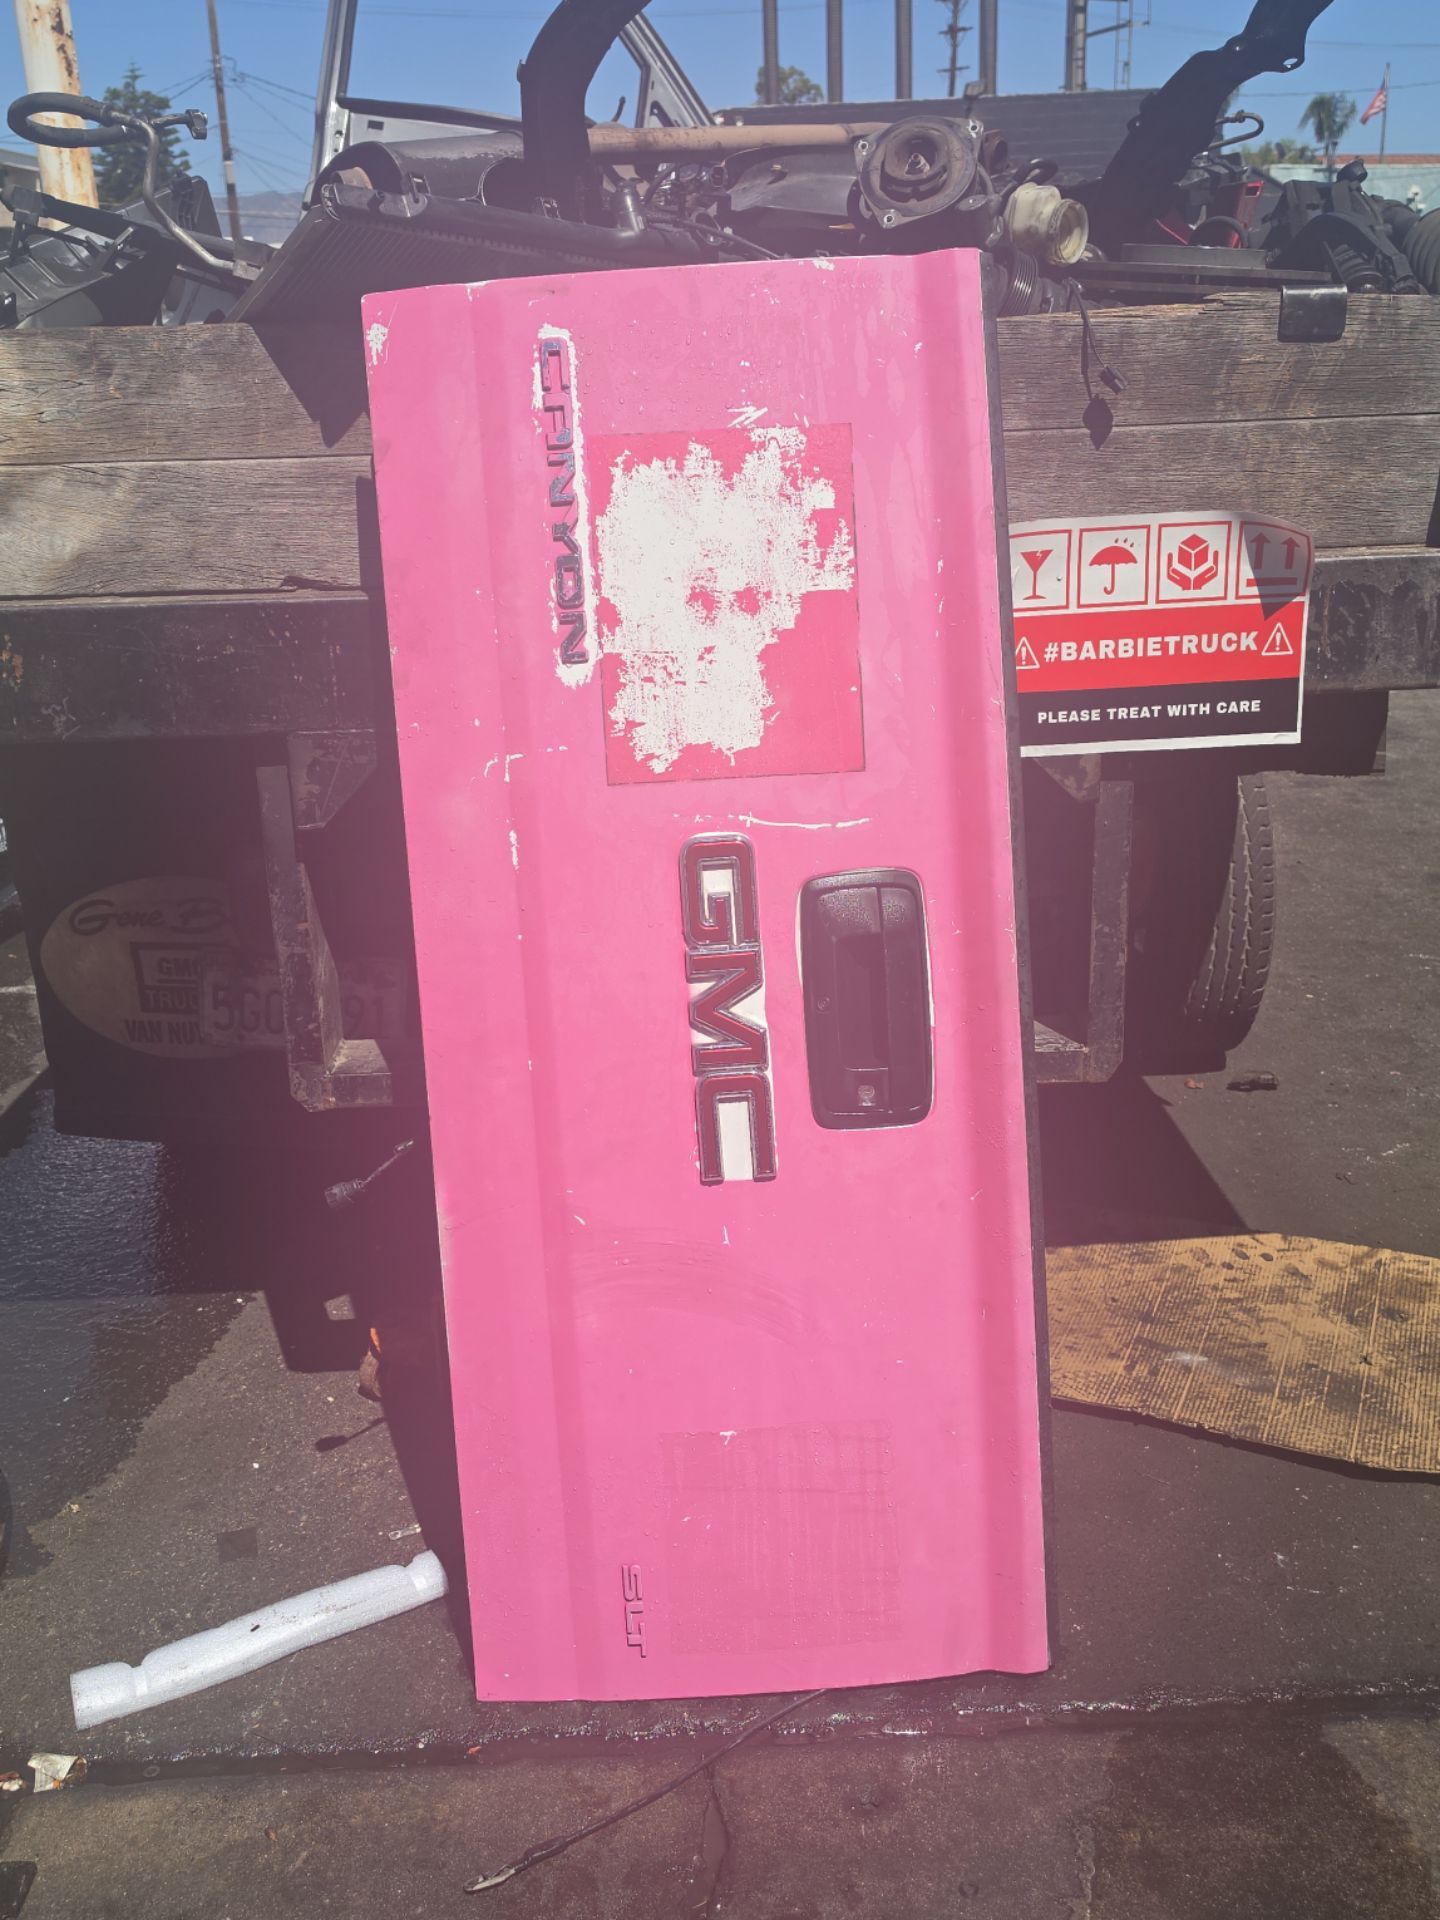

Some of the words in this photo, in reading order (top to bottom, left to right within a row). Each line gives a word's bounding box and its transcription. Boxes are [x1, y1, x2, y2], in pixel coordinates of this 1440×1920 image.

[540, 337, 590, 665] CANYON
[1043, 631, 1259, 662] #BARBIETRUCK
[1037, 709, 1101, 724] PLEASE
[1107, 705, 1162, 720] TREAT
[1168, 702, 1211, 717] WITH
[1216, 700, 1262, 713] CARE
[68, 898, 167, 936] Gene
[144, 989, 200, 1011] TRUC
[680, 832, 777, 1185] GMC
[124, 1019, 163, 1043] VAN
[621, 1564, 646, 1658] SLT
